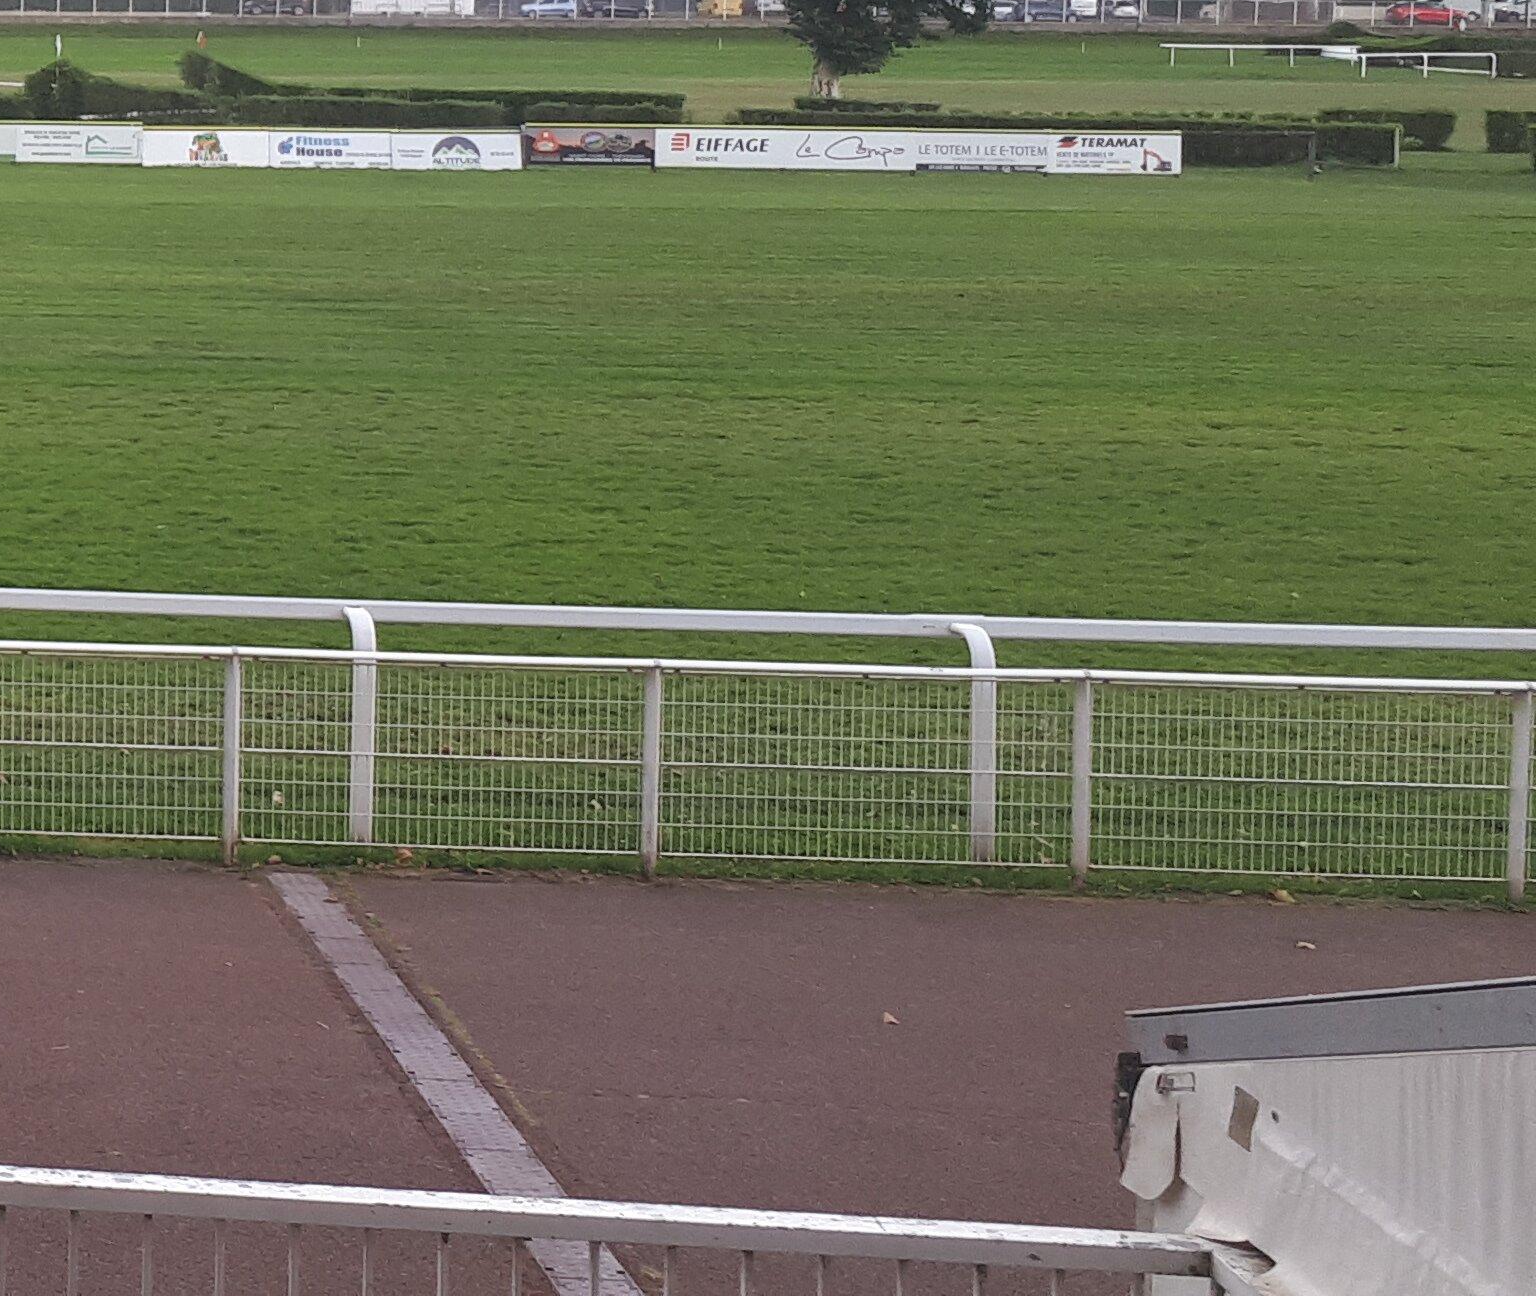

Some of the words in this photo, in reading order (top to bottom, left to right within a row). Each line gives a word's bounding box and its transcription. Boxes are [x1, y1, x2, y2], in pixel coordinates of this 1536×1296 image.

[296, 136, 349, 146] Fitness
[696, 138, 769, 152] EIFFAGE
[1081, 137, 1146, 148] TERAMAT
[296, 147, 343, 156] House
[918, 145, 930, 154] LE
[935, 145, 971, 155] TOTEM
[984, 147, 996, 155] LE
[999, 146, 1048, 156] E-TOTEM
